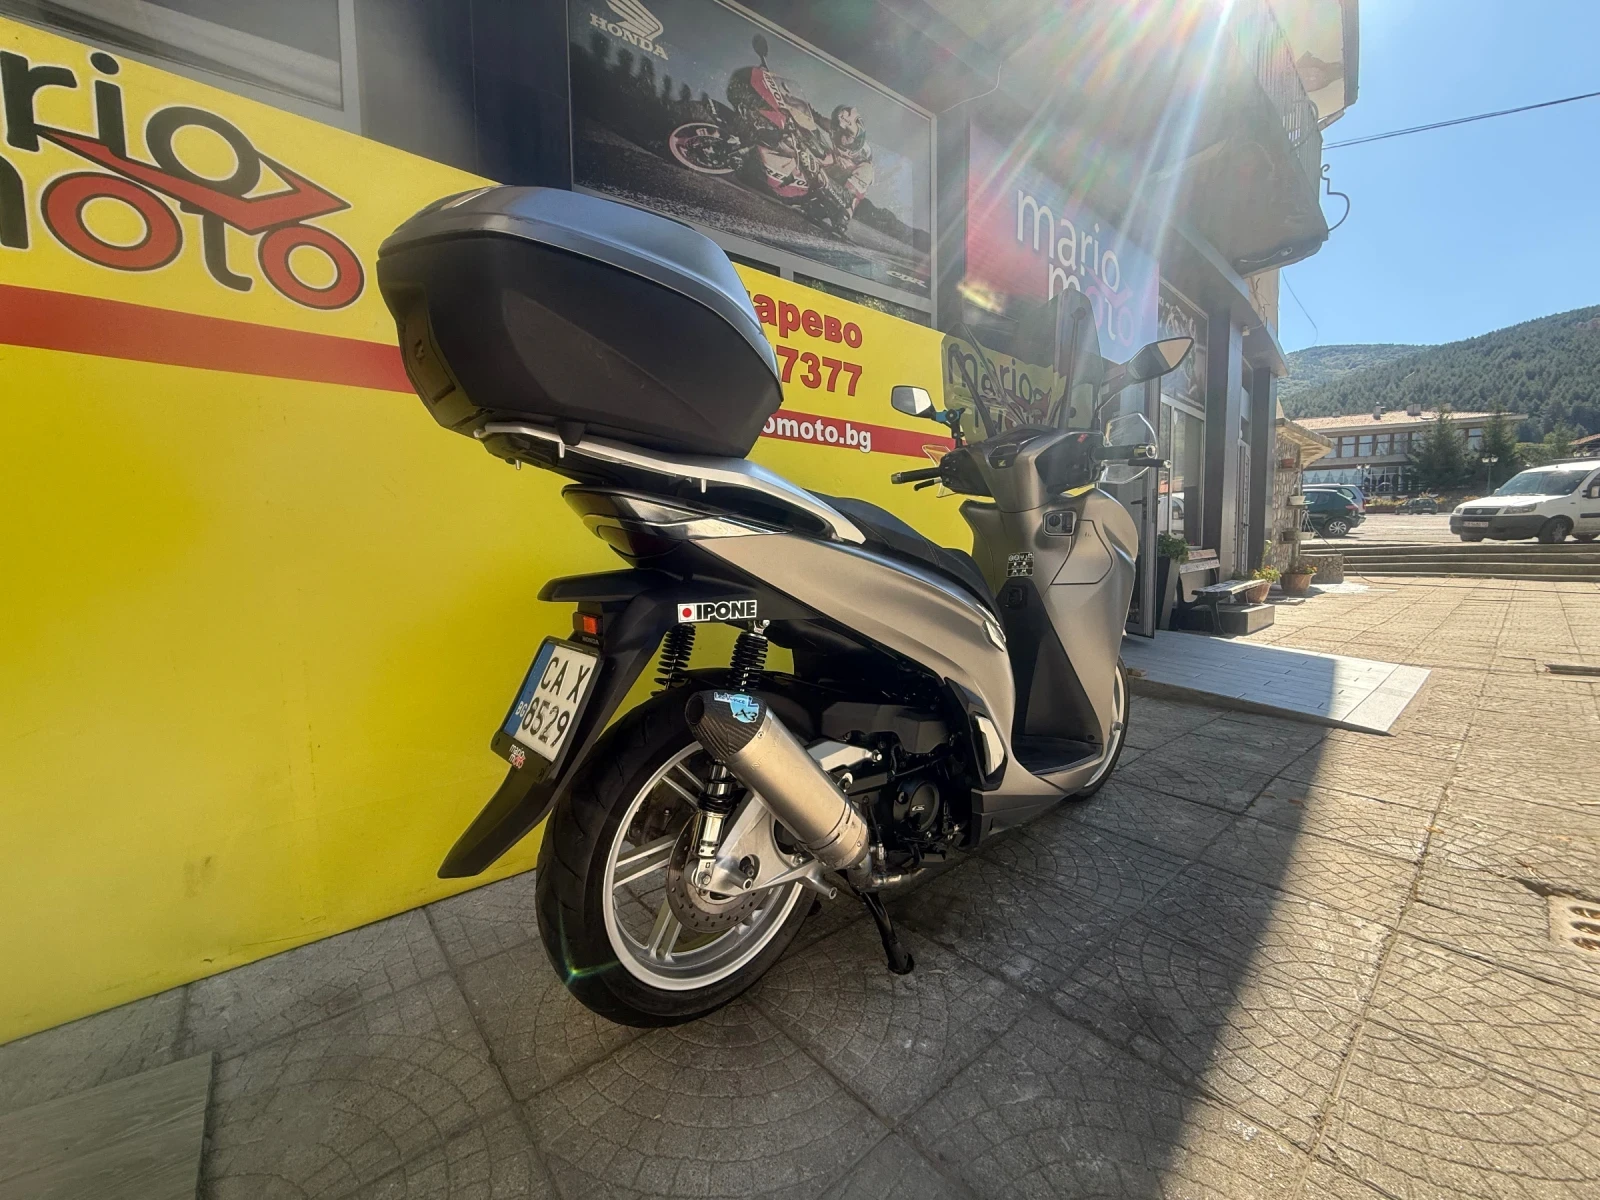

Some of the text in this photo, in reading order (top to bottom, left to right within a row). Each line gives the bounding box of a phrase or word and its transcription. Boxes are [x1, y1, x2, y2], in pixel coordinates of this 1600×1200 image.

[589, 12, 669, 60] HONDA
[1016, 189, 1121, 293] mario
[747, 291, 863, 349] арево
[695, 600, 757, 620] IPONE
[540, 656, 591, 704] CA X
[514, 700, 528, 718] BG
[521, 697, 571, 748] 8529
